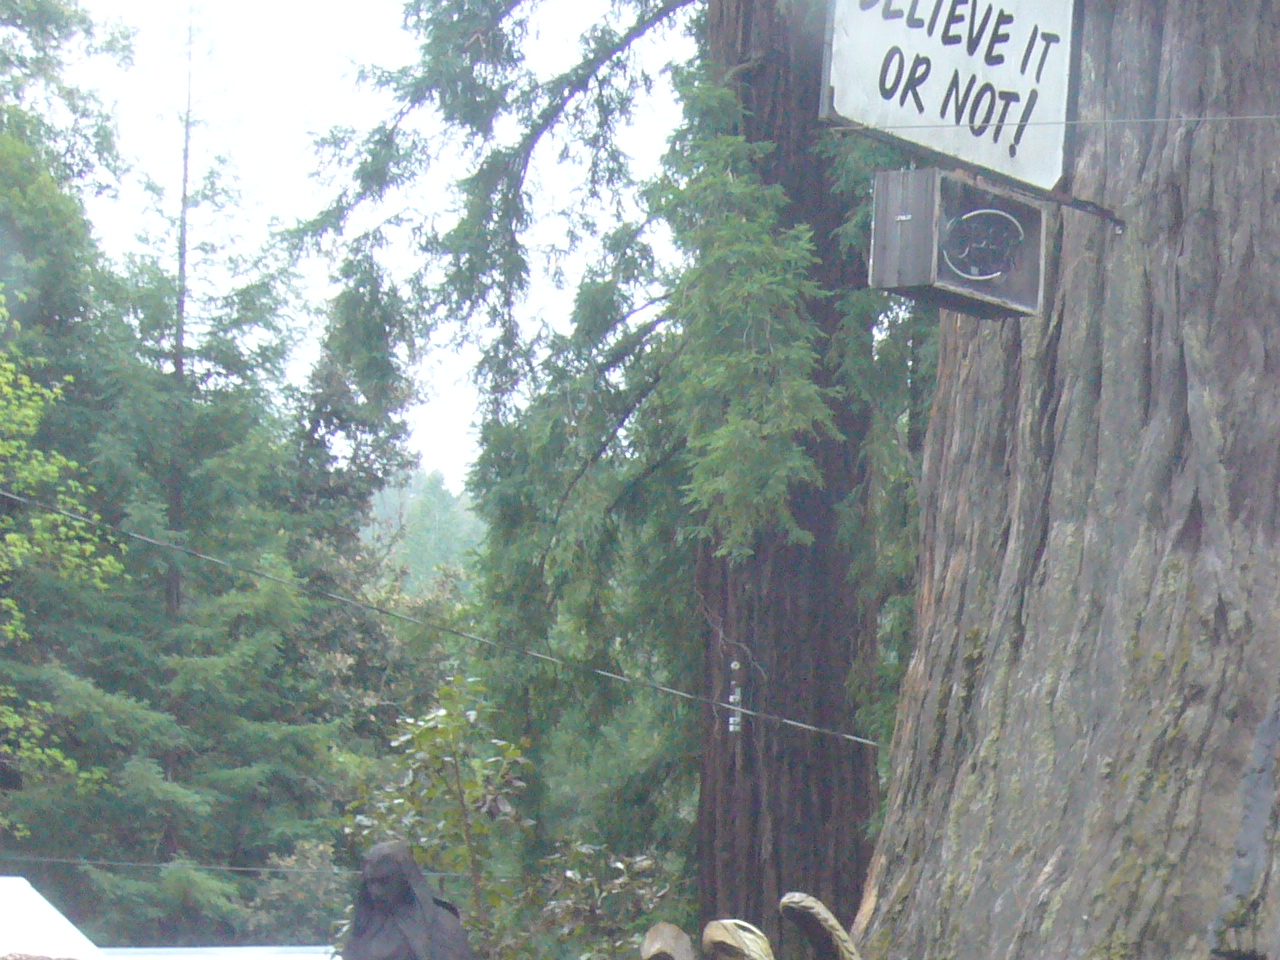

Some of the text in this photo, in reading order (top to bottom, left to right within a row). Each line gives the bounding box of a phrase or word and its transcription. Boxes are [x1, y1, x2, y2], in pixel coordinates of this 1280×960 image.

[859, 0, 1060, 83] LIEVE IT
[879, 45, 1038, 158] OR NOT!
